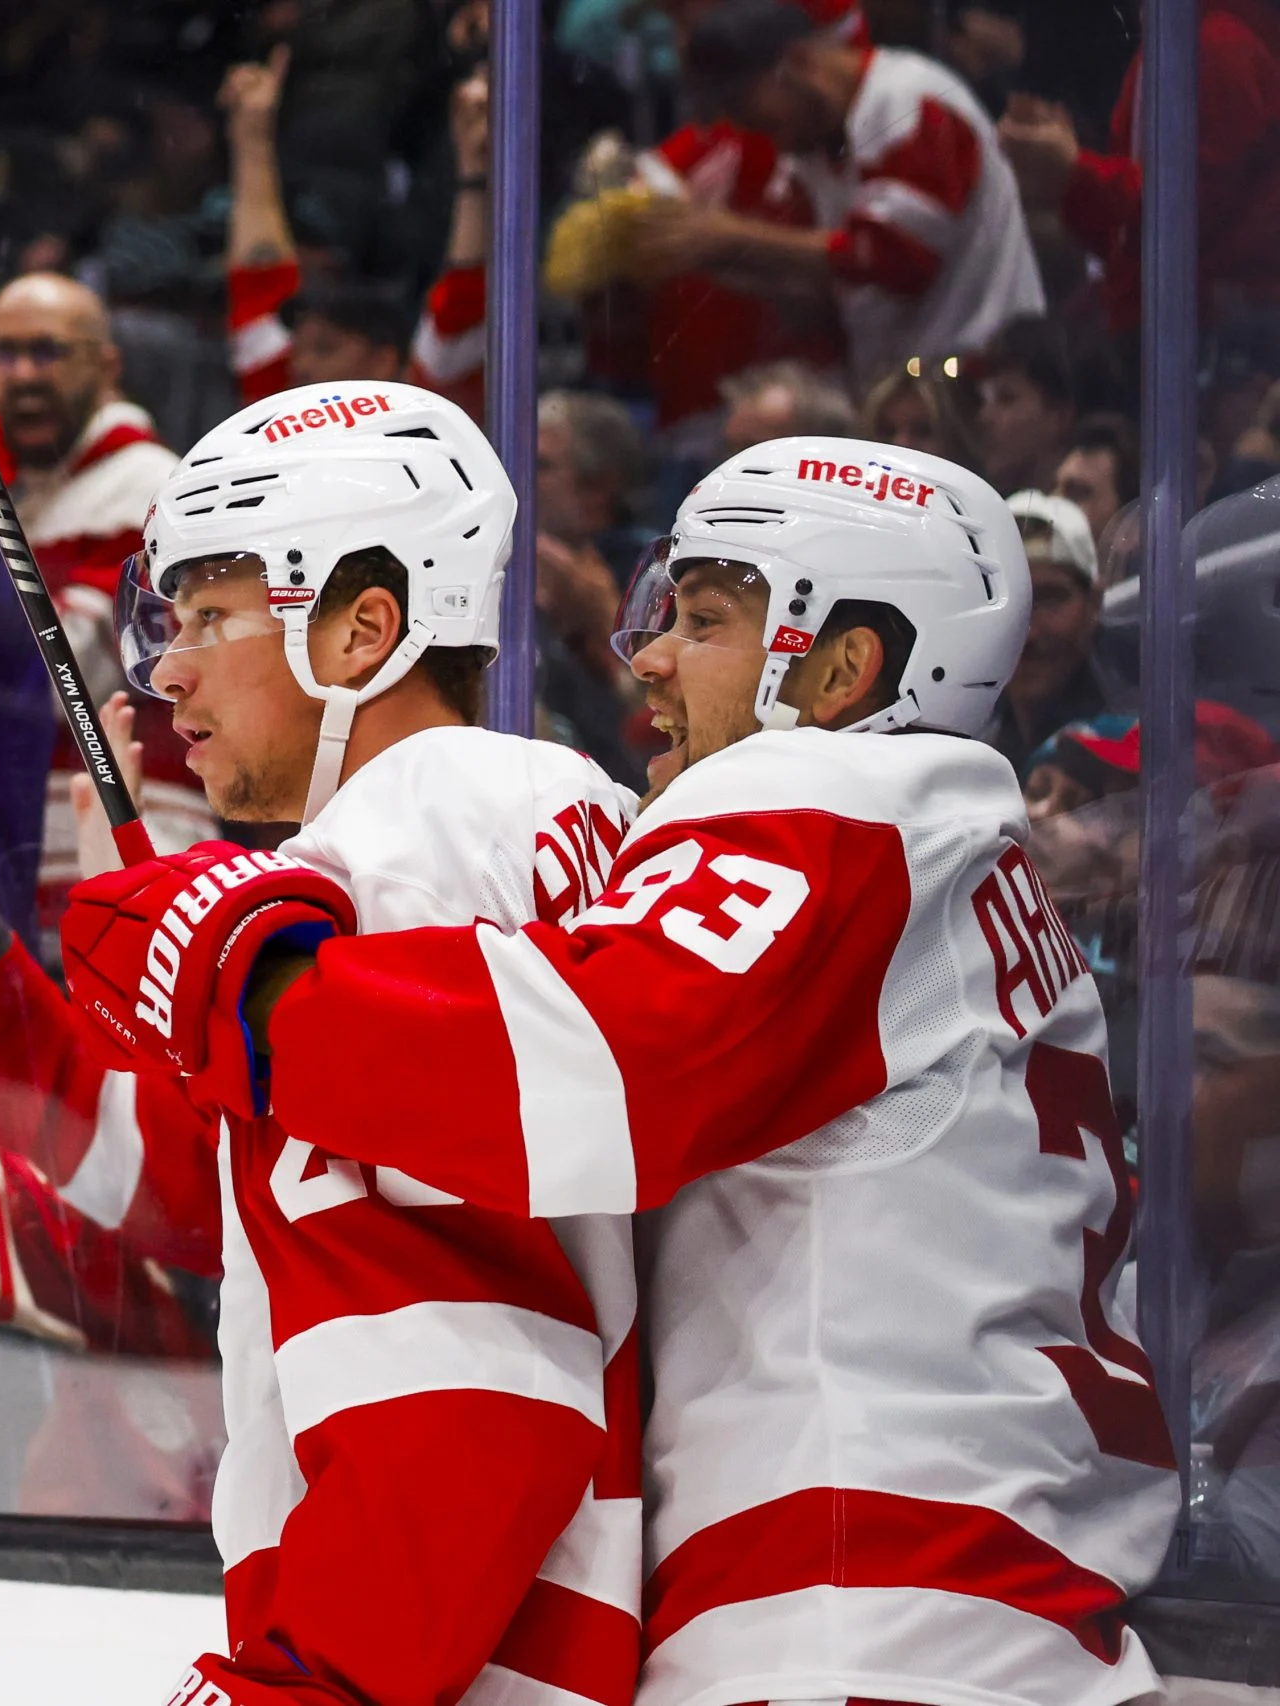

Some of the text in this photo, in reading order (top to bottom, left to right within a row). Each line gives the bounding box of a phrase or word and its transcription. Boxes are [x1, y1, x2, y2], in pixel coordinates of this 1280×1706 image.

[263, 394, 393, 444] meijer
[797, 460, 934, 507] meijer
[270, 590, 314, 599] BAUER
[55, 662, 81, 696] MAX
[135, 851, 316, 1039] ARRIOR
